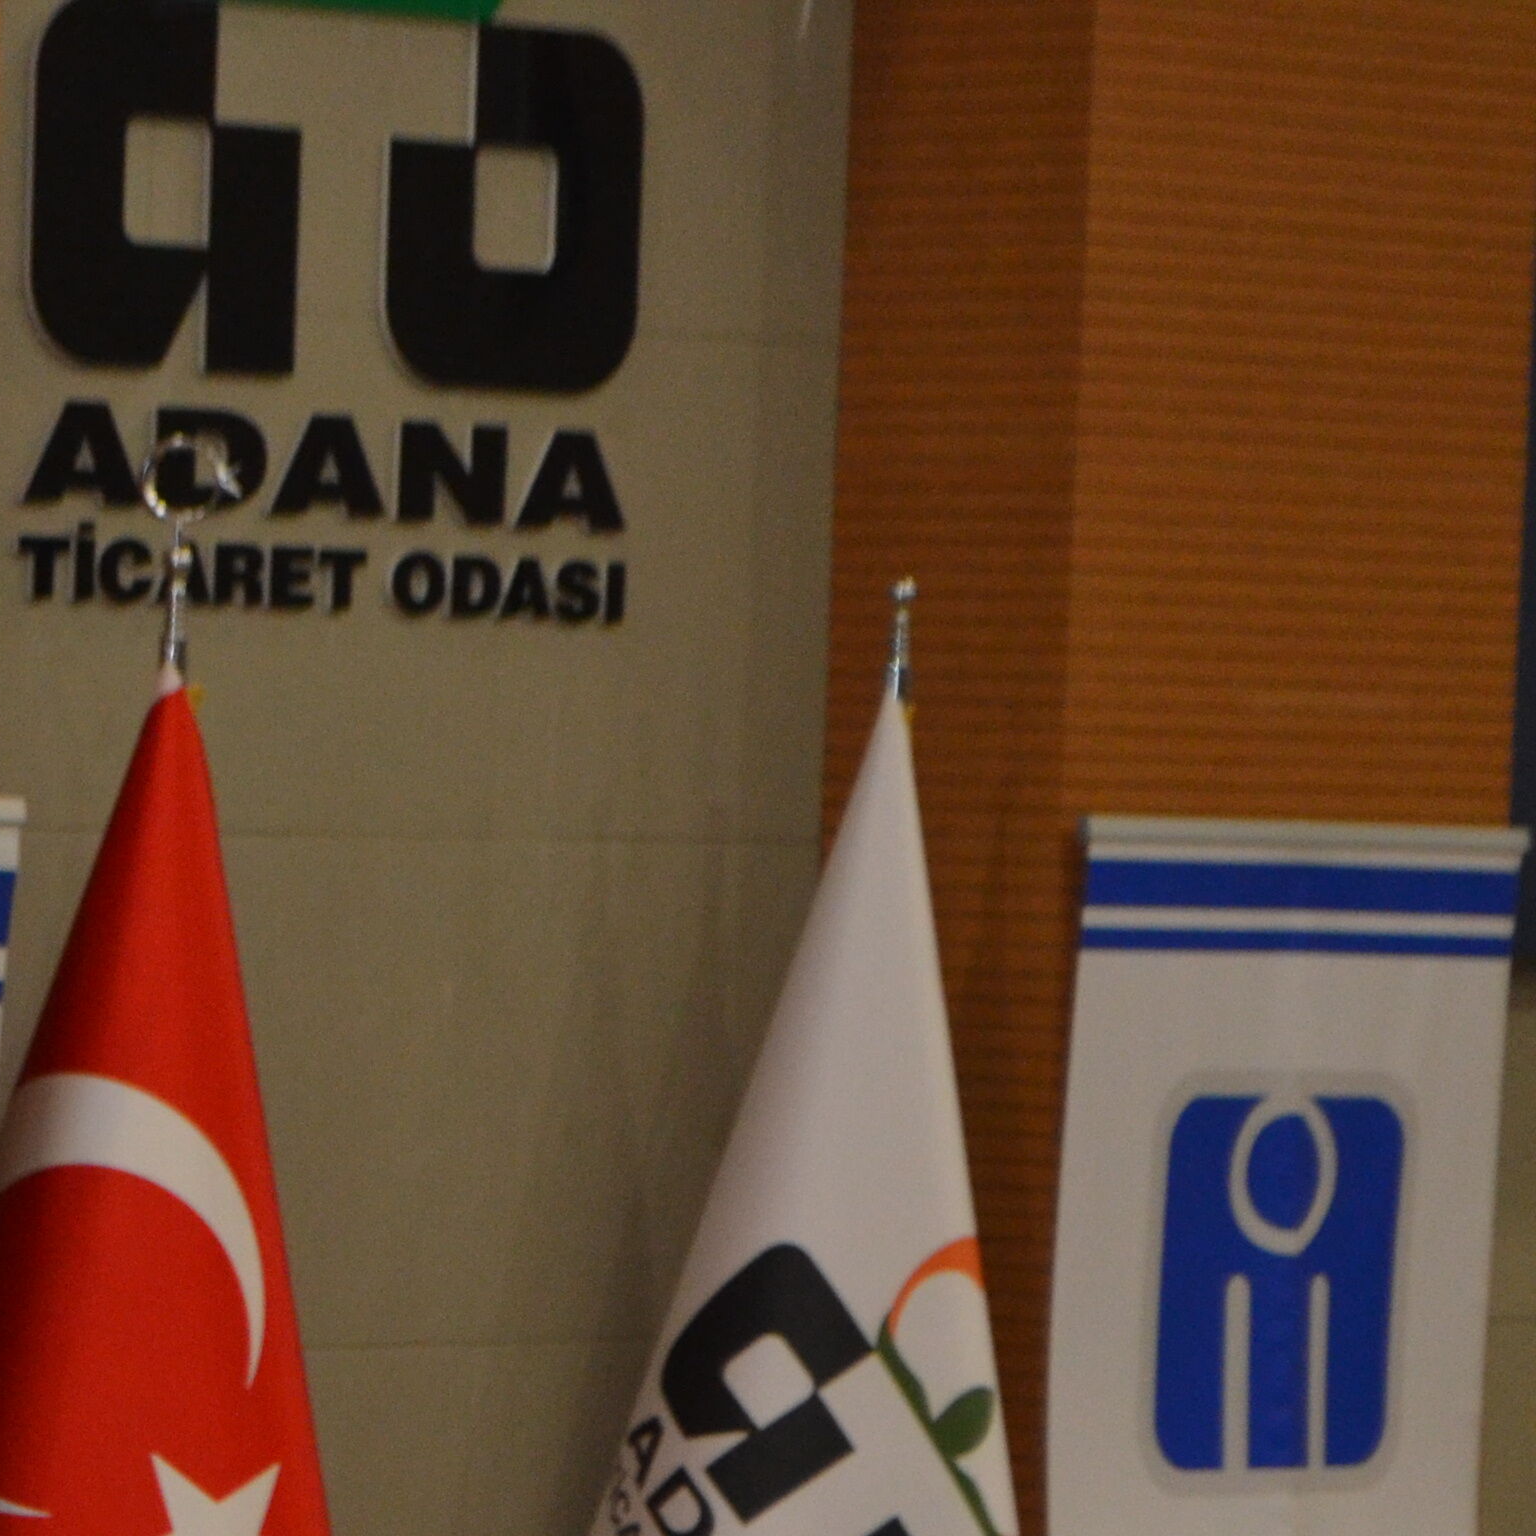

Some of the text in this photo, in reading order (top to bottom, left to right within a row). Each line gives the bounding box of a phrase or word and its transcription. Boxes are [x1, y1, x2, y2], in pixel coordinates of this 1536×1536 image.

[22, 400, 626, 532] ADANA
[18, 522, 627, 625] TİCARET ODASI
